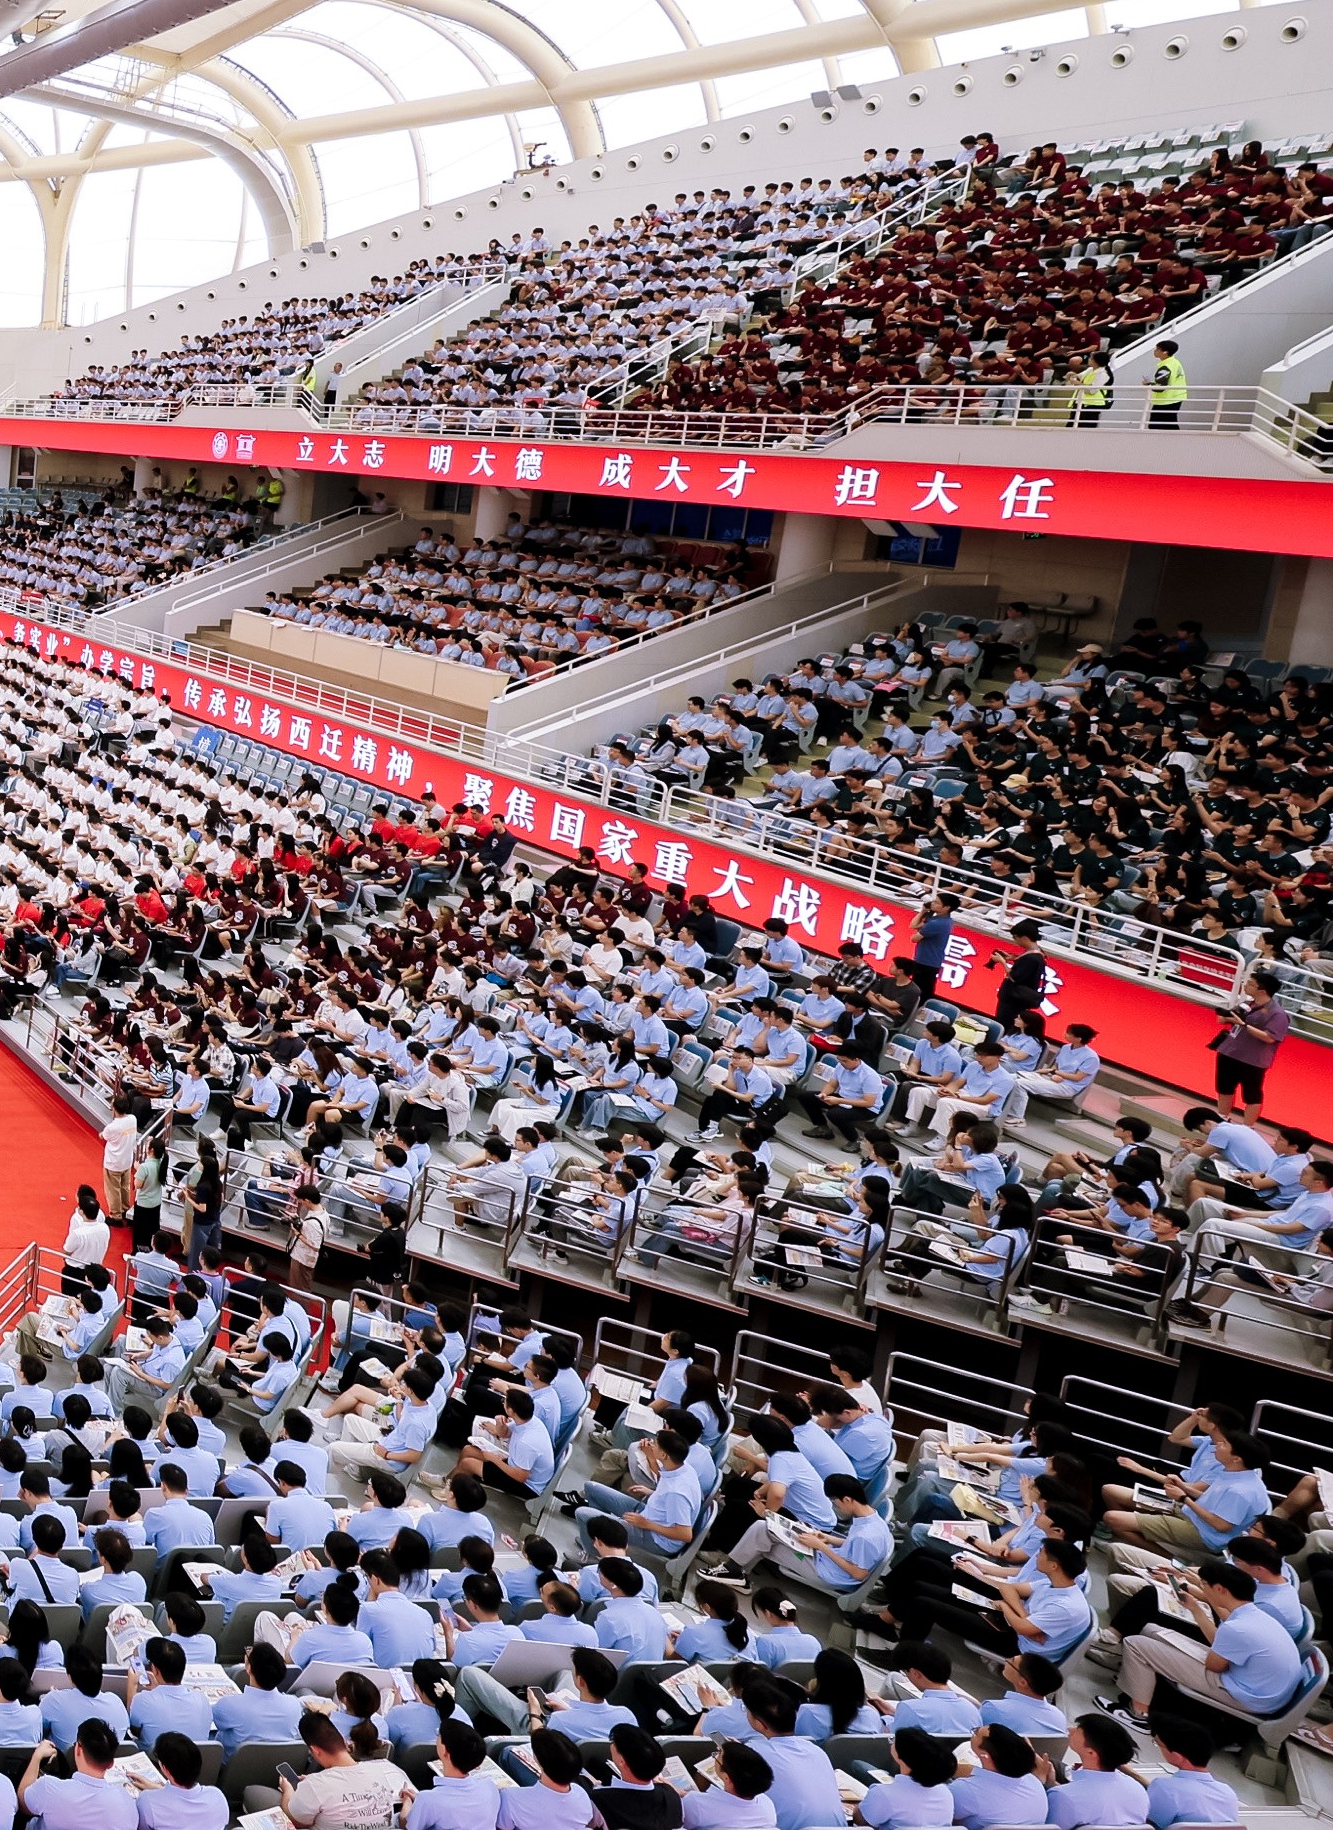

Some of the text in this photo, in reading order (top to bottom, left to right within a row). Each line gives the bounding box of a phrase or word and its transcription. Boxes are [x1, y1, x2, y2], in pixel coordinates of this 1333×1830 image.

[295, 435, 1056, 520] 立大志 明大德 成大才 担大任
